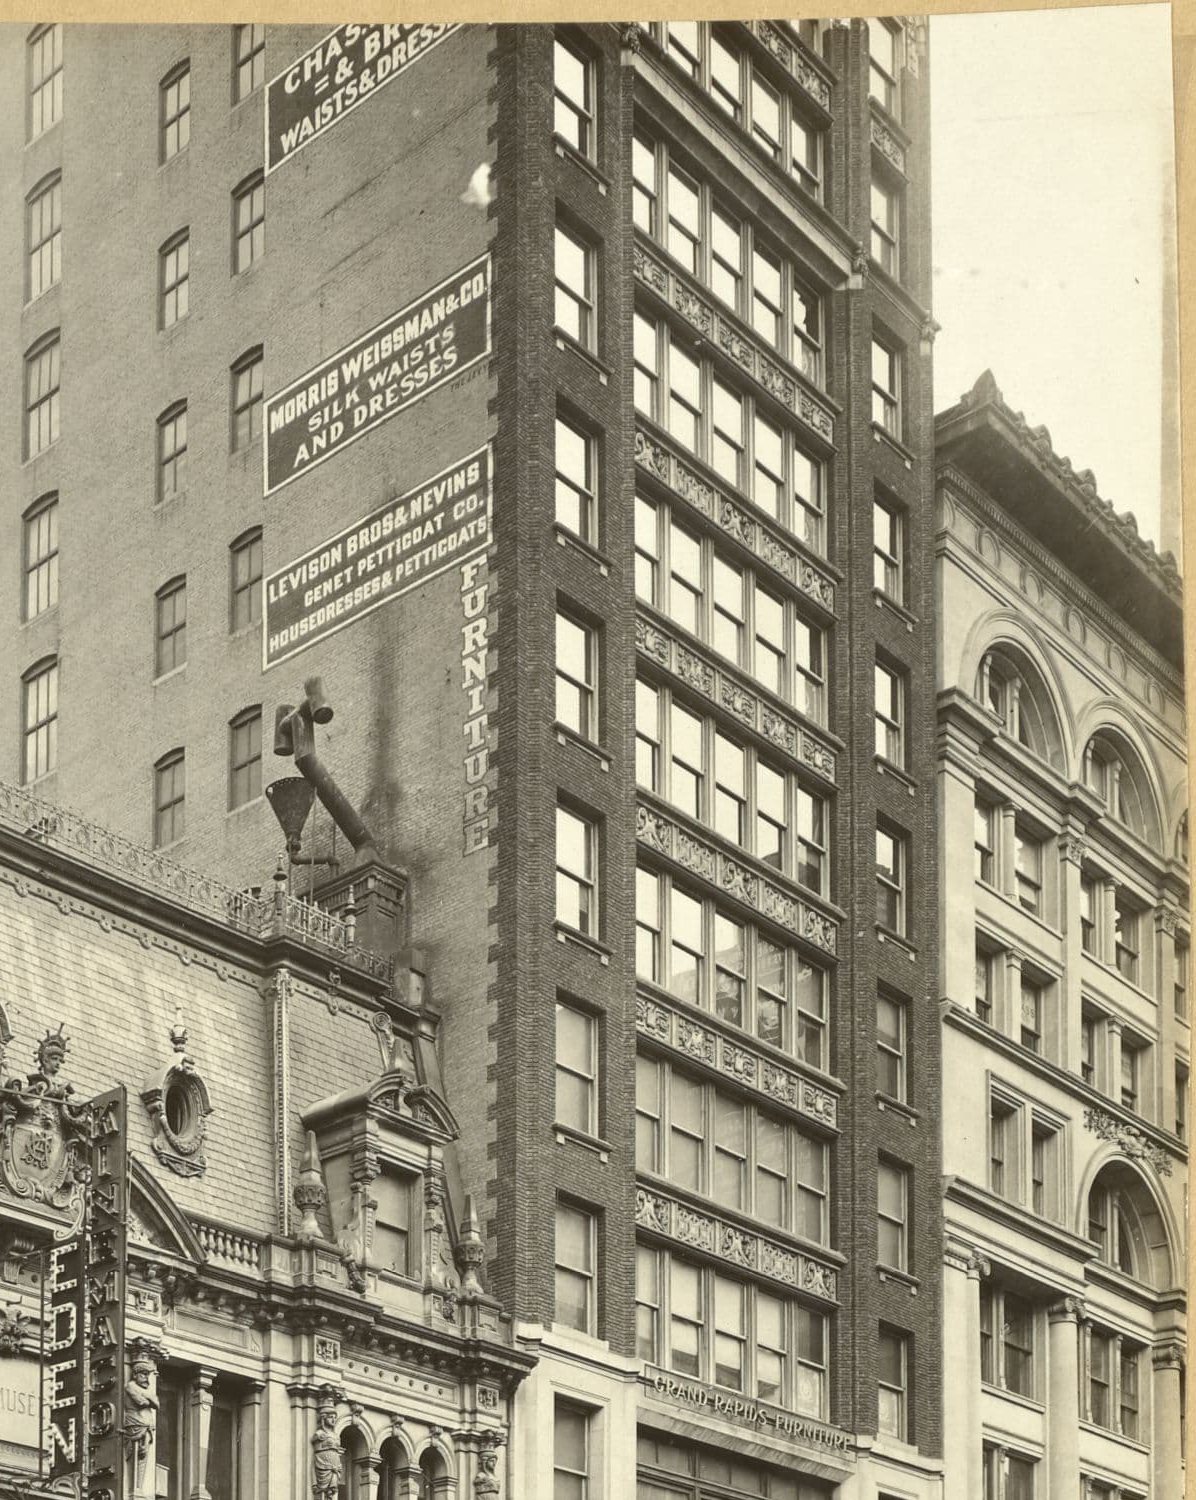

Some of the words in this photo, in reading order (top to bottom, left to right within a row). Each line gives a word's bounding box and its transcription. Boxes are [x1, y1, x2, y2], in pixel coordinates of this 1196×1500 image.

[335, 57, 353, 85] &
[270, 369, 339, 435] MORRIS
[293, 420, 345, 469] AND
[353, 345, 458, 429] DRESSES
[307, 384, 360, 433] SILK
[368, 321, 455, 393] WAISTS
[268, 543, 343, 605] LEVISON
[304, 565, 354, 608] GENET
[357, 511, 446, 578] PETTICOAT
[453, 493, 485, 522] CO.
[459, 553, 489, 858] FURNITURE
[49, 1241, 79, 1469] EDEN
[653, 1374, 709, 1408] GRAND
[714, 1393, 768, 1427] RAPIDS
[775, 1413, 855, 1457] FURNITURE
